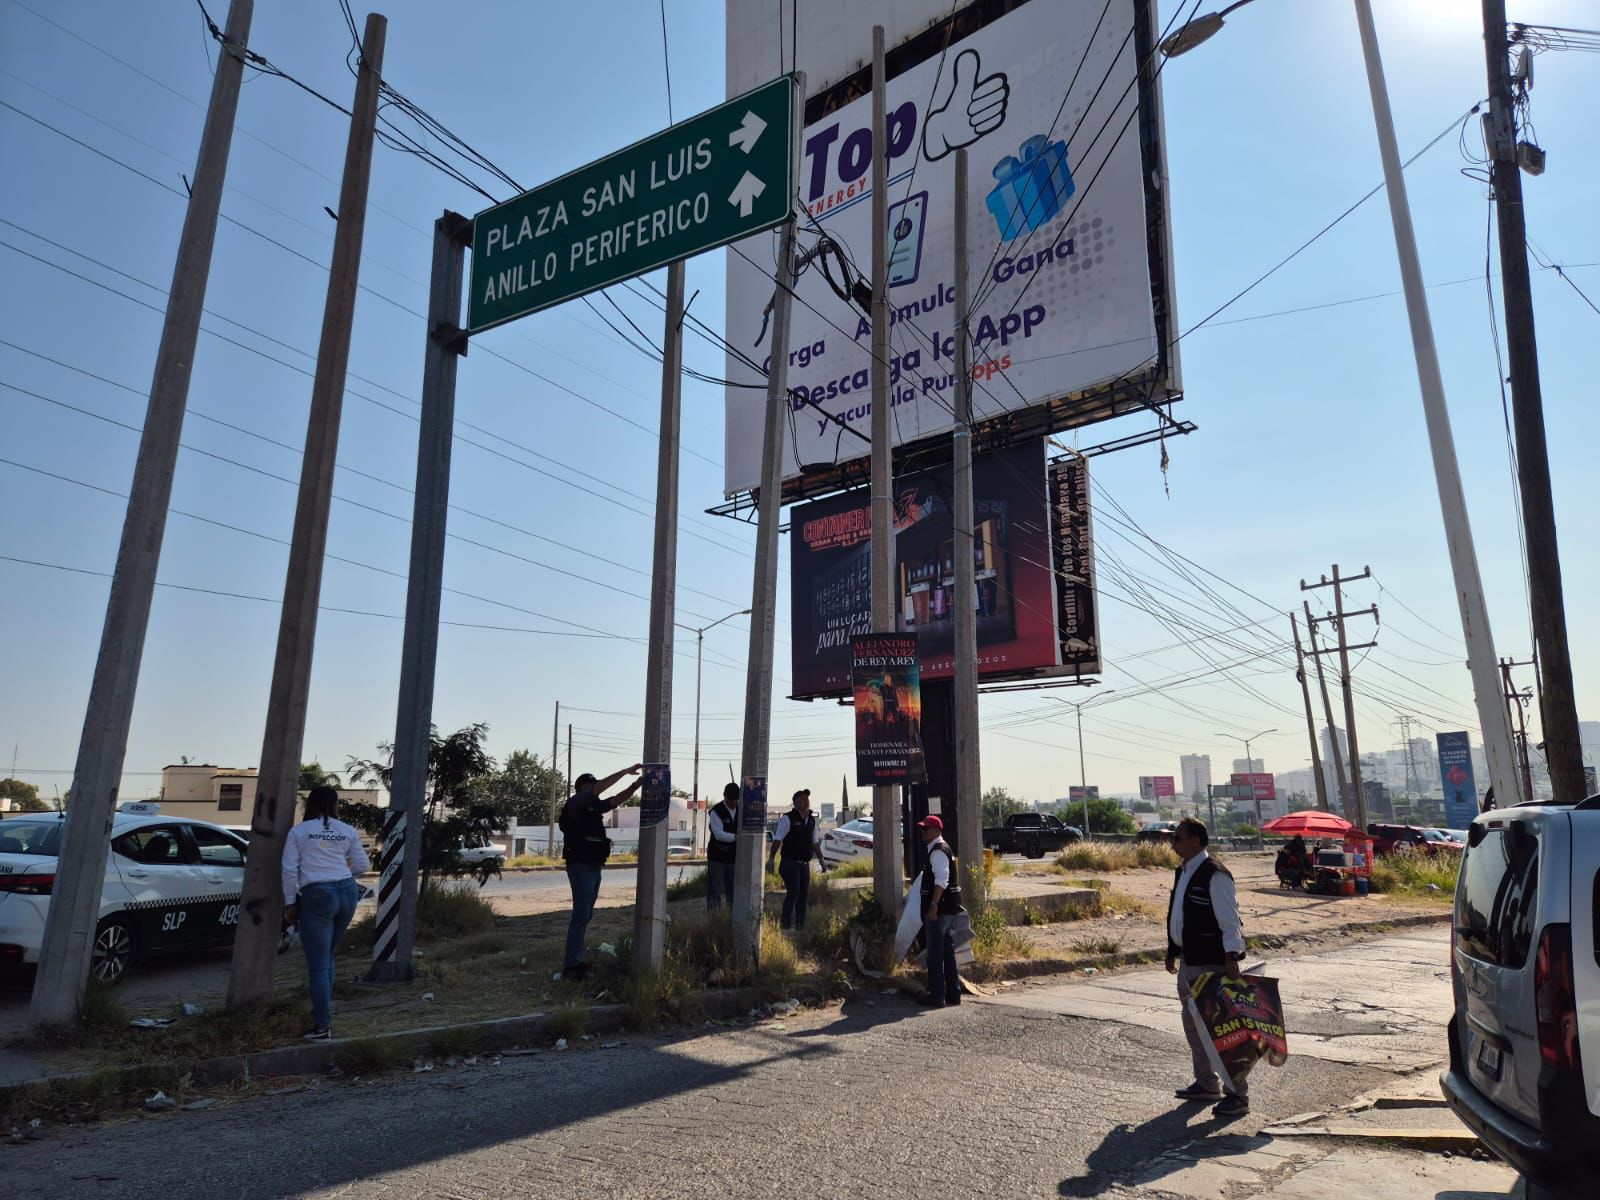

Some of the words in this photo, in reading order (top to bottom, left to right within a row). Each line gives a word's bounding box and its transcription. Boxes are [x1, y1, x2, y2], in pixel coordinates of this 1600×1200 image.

[805, 101, 918, 203] Top
[486, 200, 569, 257] PLAZA
[581, 169, 636, 217] SAN
[650, 137, 712, 190] LUIS
[807, 178, 867, 216] ENERGY
[483, 251, 557, 305] ANILLO
[570, 191, 710, 273] PERIFERICO
[992, 239, 1075, 284] Gana
[791, 349, 921, 412] Descaga
[973, 303, 1046, 348] App
[818, 416, 830, 437] y
[853, 640, 916, 650] ALEJANDRO
[853, 658, 869, 667] DE
[870, 657, 887, 666] REY
[889, 657, 896, 665] A
[897, 656, 915, 665] REY
[161, 911, 187, 932] SLP
[1214, 1018, 1240, 1037] SAN
